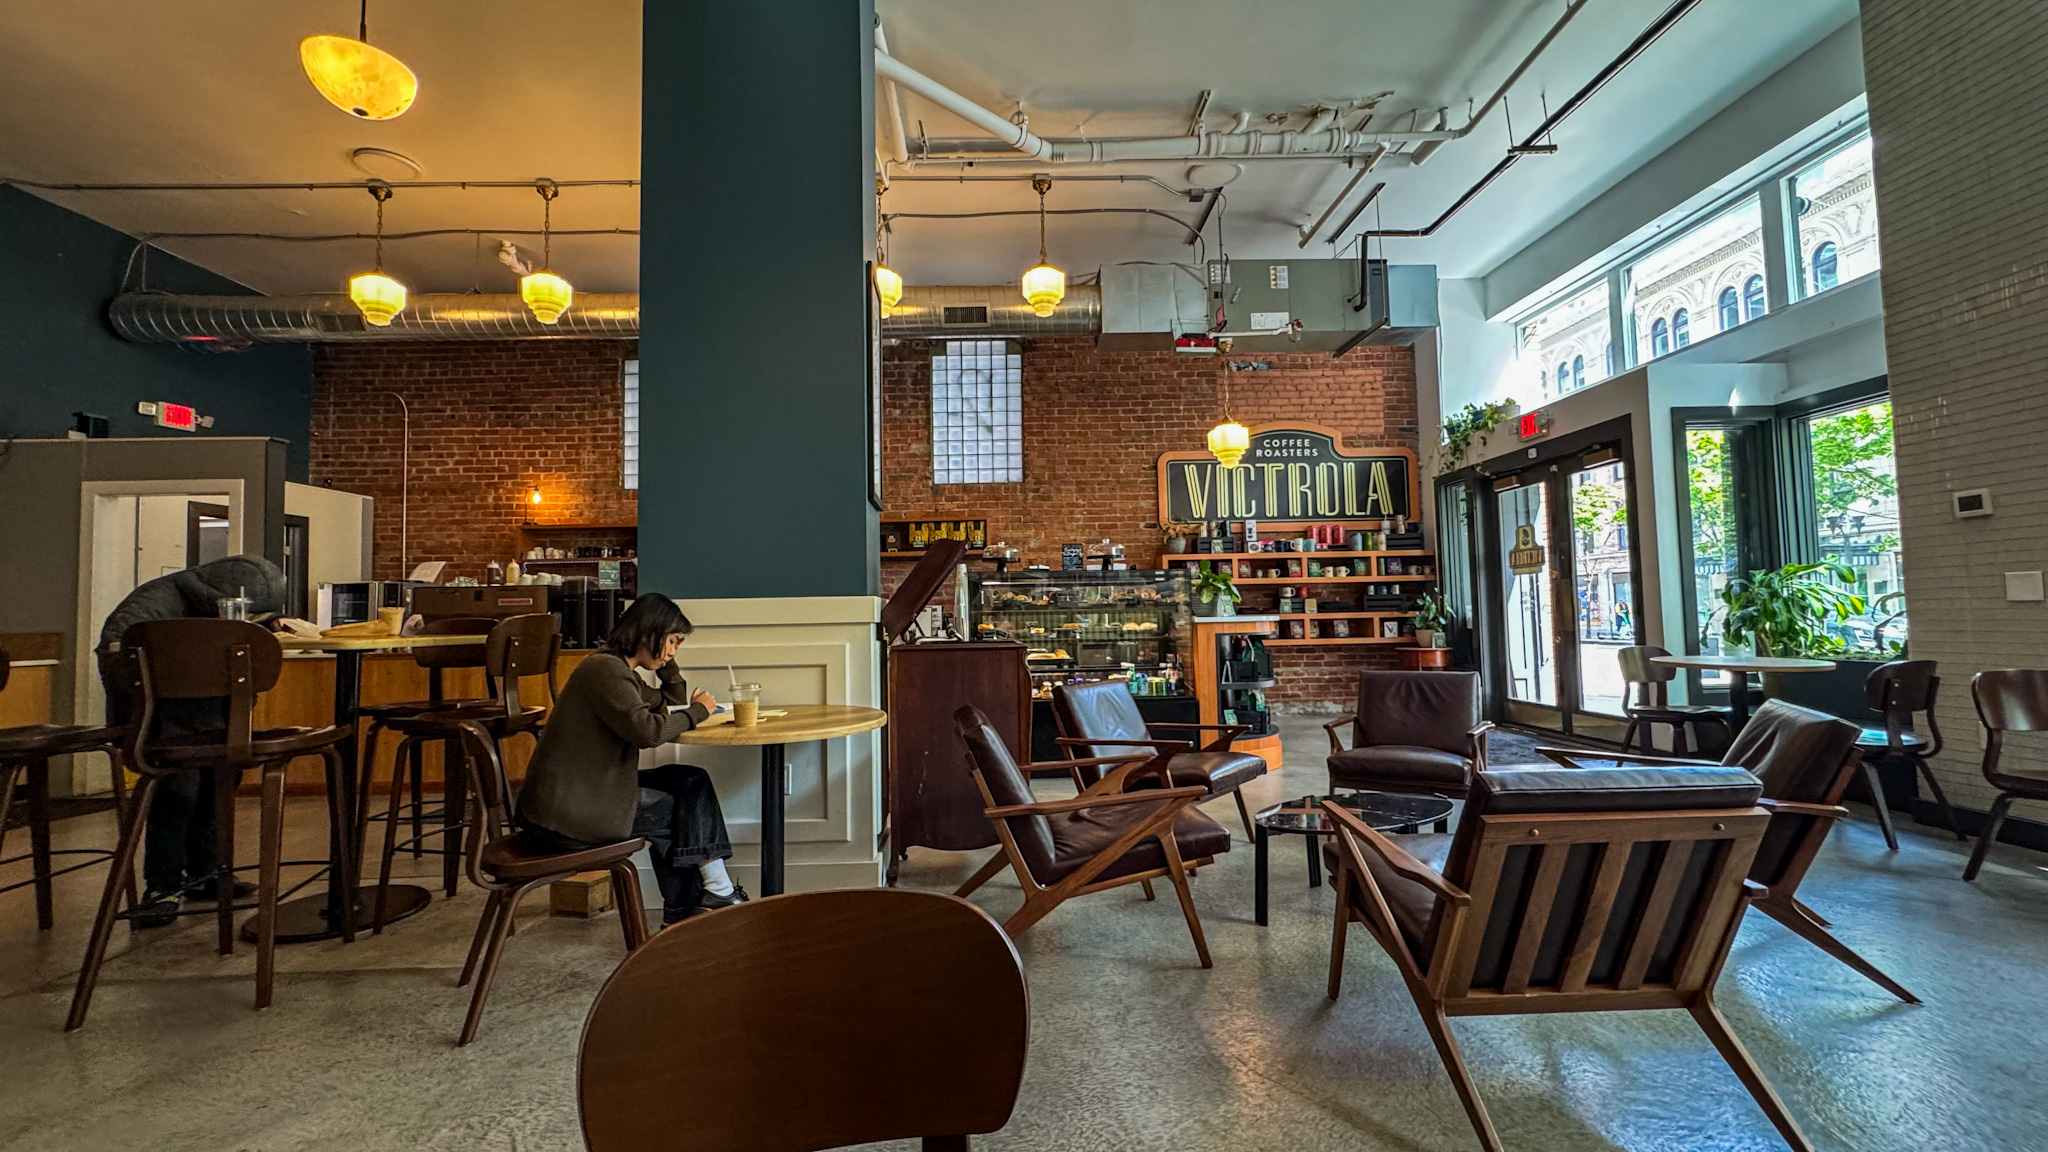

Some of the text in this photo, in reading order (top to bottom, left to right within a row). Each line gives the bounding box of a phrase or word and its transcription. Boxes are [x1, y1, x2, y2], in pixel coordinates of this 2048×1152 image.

[1263, 439, 1311, 448] COFFEE
[1256, 448, 1319, 457] ROASTERS
[1184, 462, 1394, 519] VICTROLA
